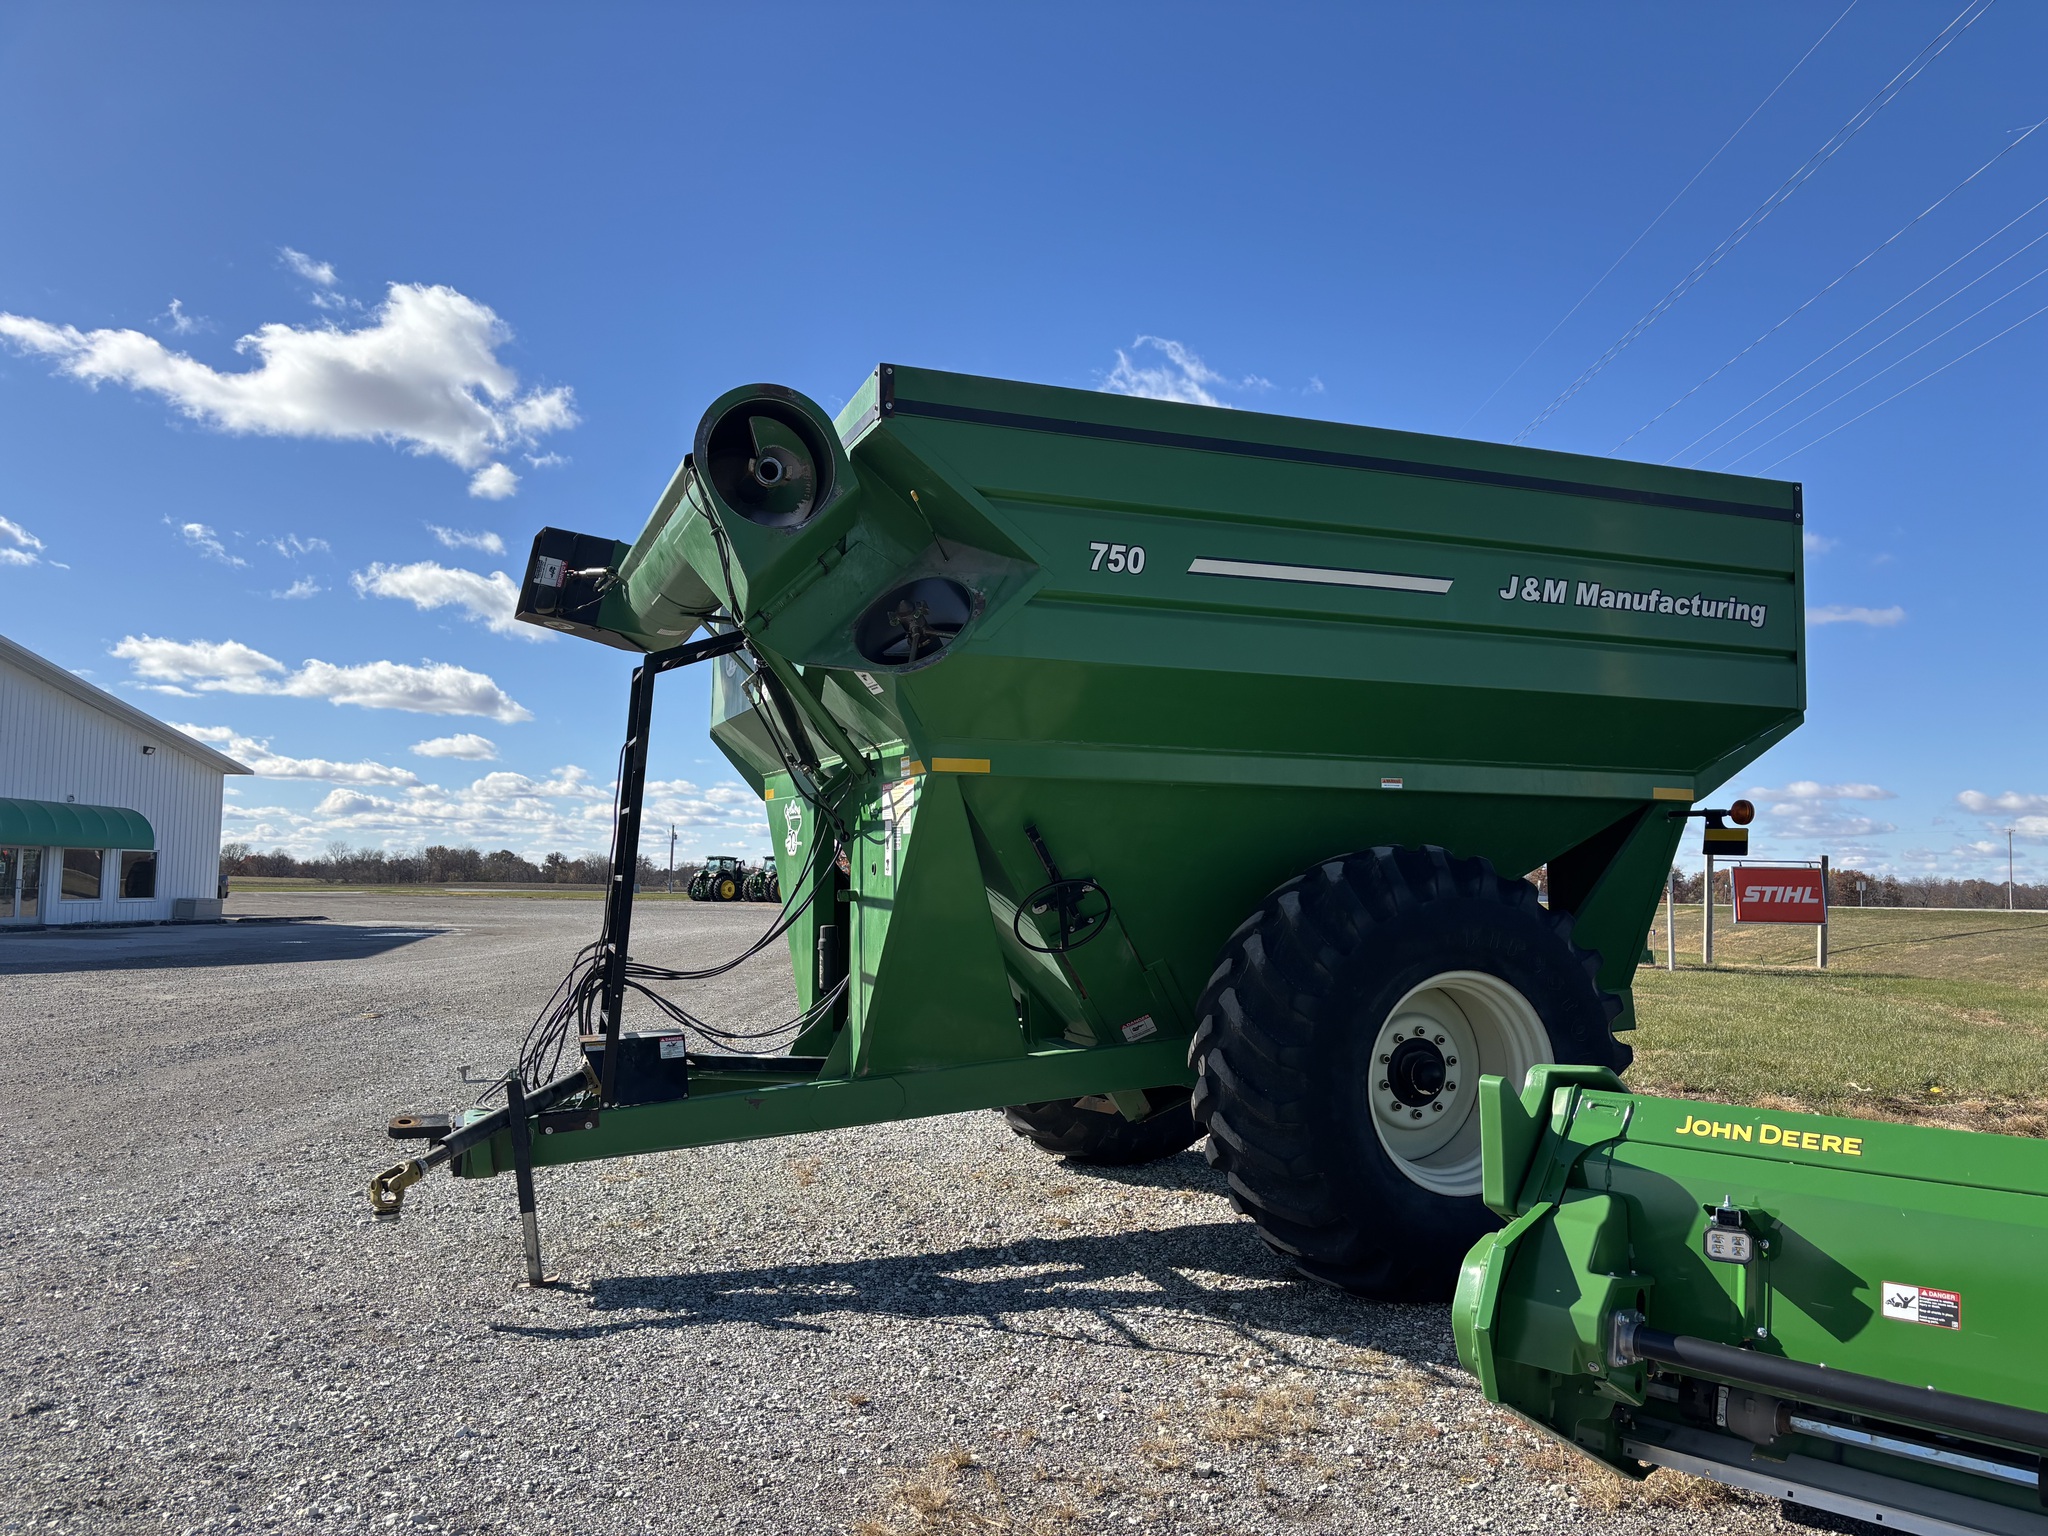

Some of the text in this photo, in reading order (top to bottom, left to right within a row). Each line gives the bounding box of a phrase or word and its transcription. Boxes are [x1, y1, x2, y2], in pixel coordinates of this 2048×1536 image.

[1089, 541, 1146, 575] 750
[1499, 574, 1767, 629] J&M Manufacturing
[1742, 885, 1820, 904] STIHL
[1675, 1115, 1864, 1156] JOHN DEERE
[1928, 1291, 1956, 1301] DANGER
